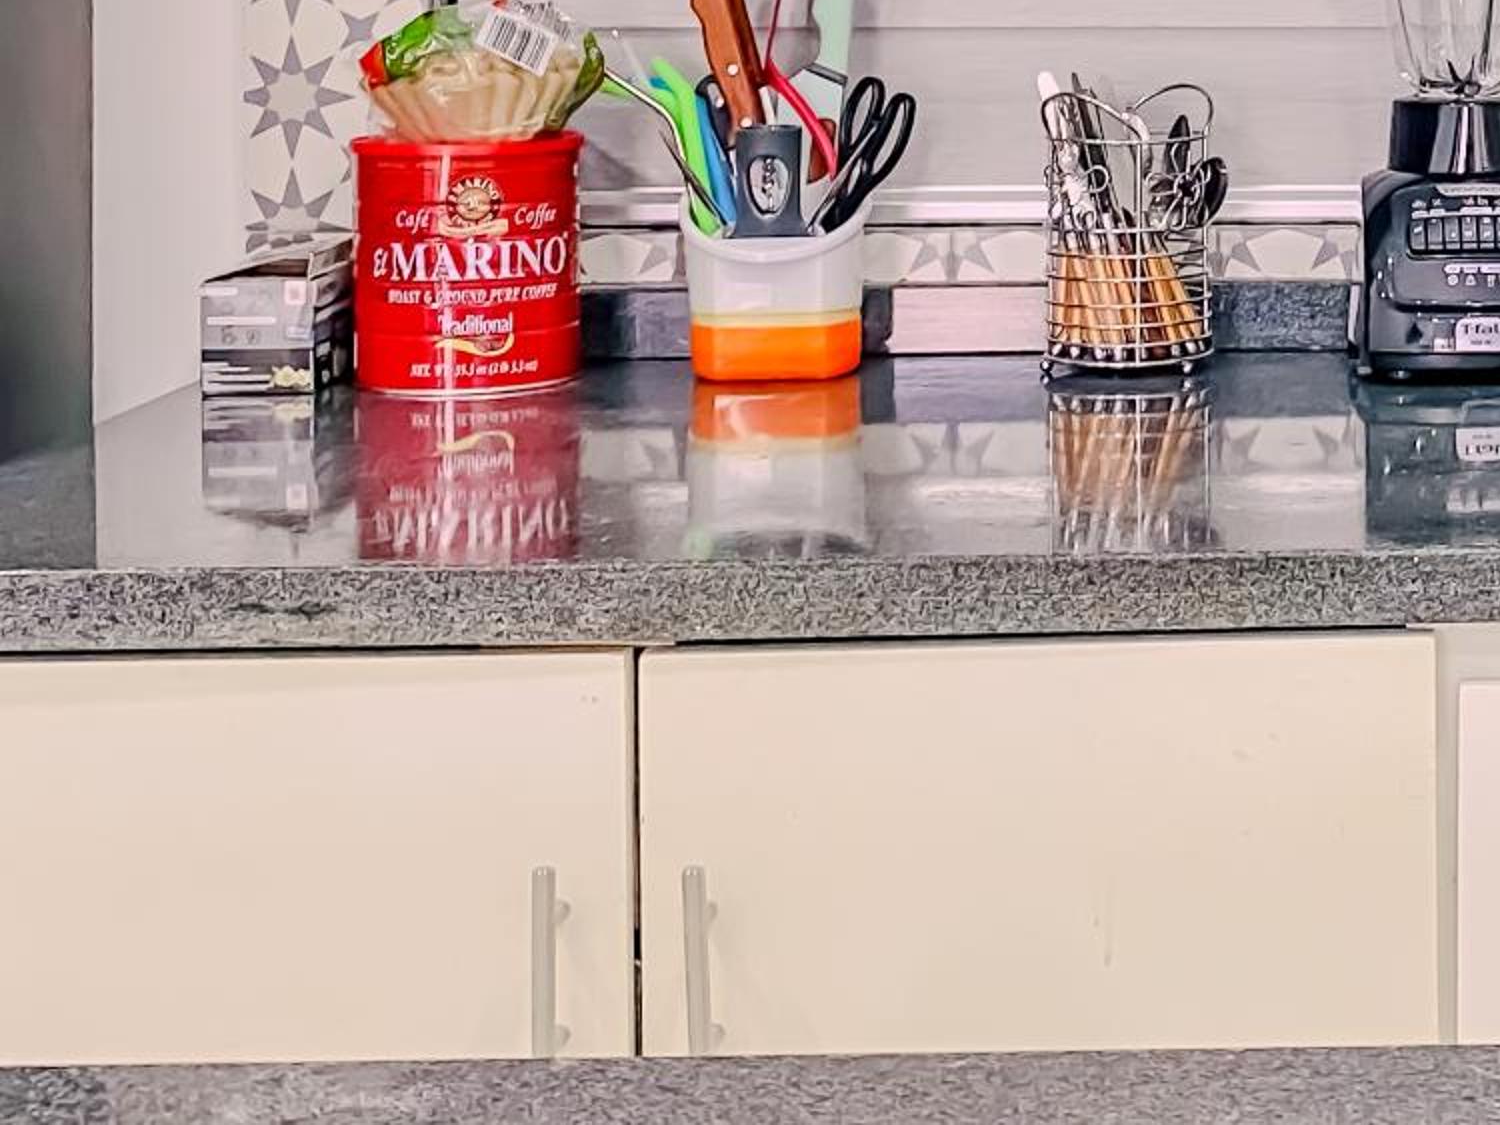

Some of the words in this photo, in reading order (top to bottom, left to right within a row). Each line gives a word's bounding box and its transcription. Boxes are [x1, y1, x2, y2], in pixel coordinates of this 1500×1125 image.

[514, 203, 557, 230] Coffee
[390, 236, 567, 283] MARINO
[437, 311, 514, 336] Traditional
